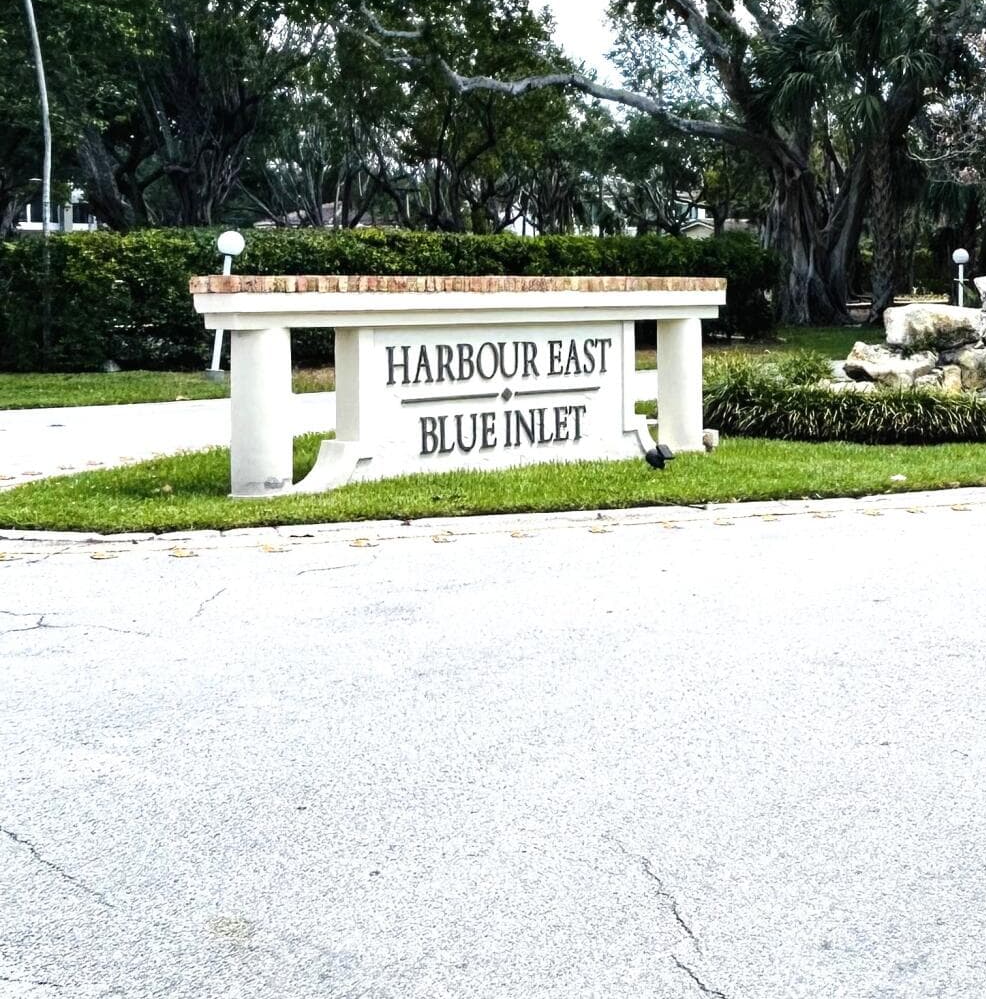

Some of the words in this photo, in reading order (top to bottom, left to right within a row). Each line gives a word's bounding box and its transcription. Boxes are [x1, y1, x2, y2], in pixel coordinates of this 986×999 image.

[385, 340, 540, 385] HARBOUR
[547, 337, 612, 376] EAST
[419, 411, 496, 455] BLUE
[503, 405, 587, 447] INLET
